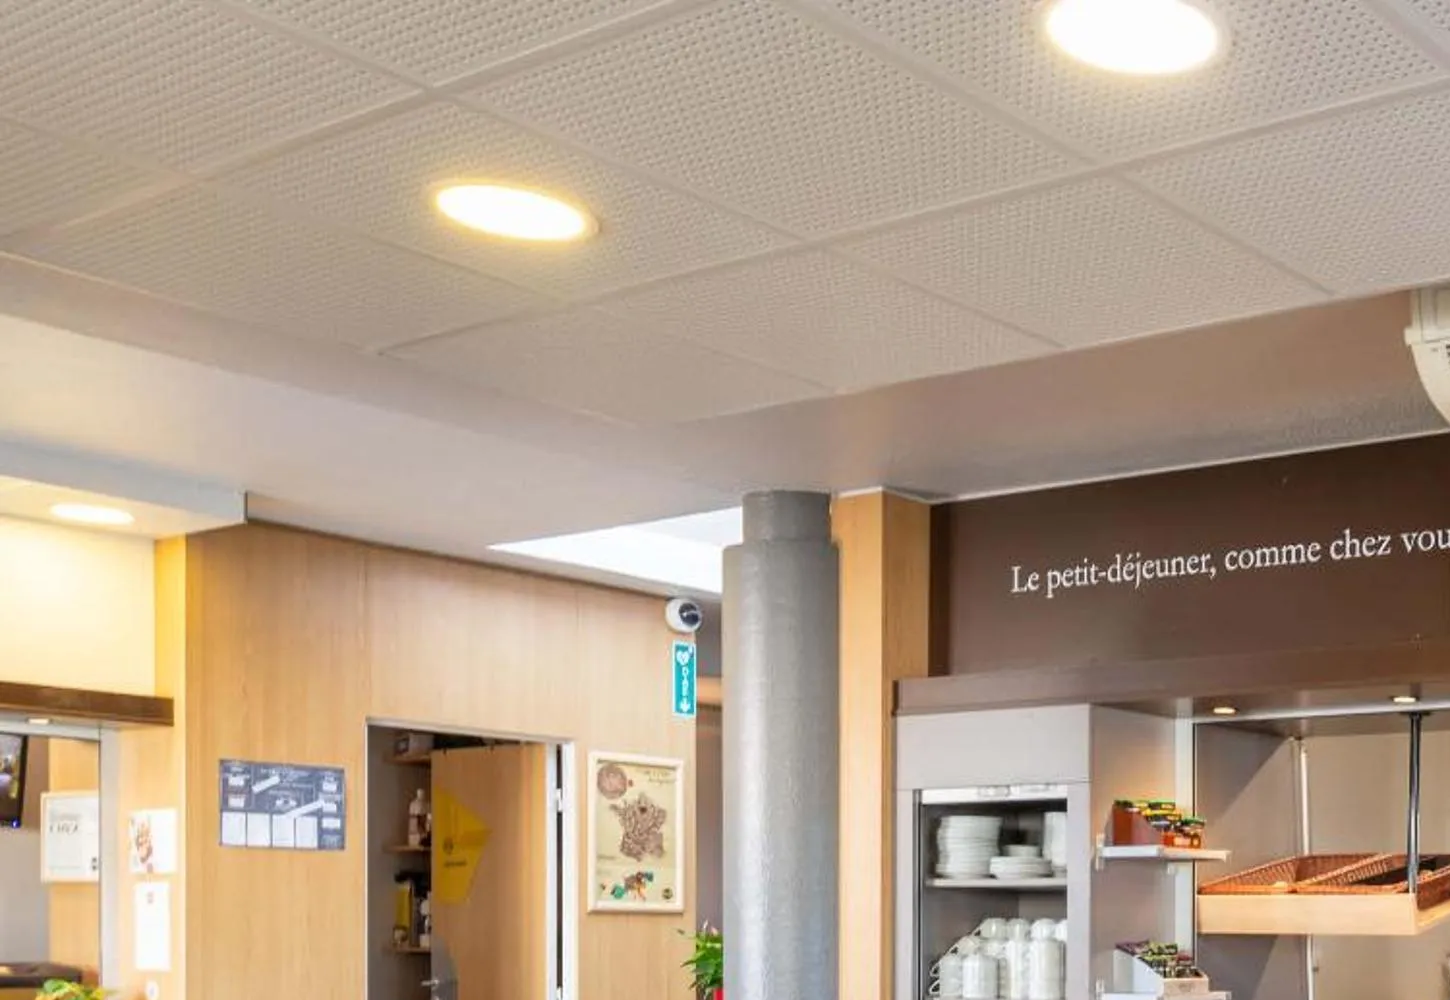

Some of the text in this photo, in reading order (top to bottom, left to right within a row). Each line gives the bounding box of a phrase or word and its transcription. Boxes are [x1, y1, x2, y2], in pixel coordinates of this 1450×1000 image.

[1010, 565, 1040, 594] Le
[1045, 551, 1217, 600] petit-déjeuner,
[1224, 542, 1322, 571] comme
[1329, 527, 1392, 561] chez
